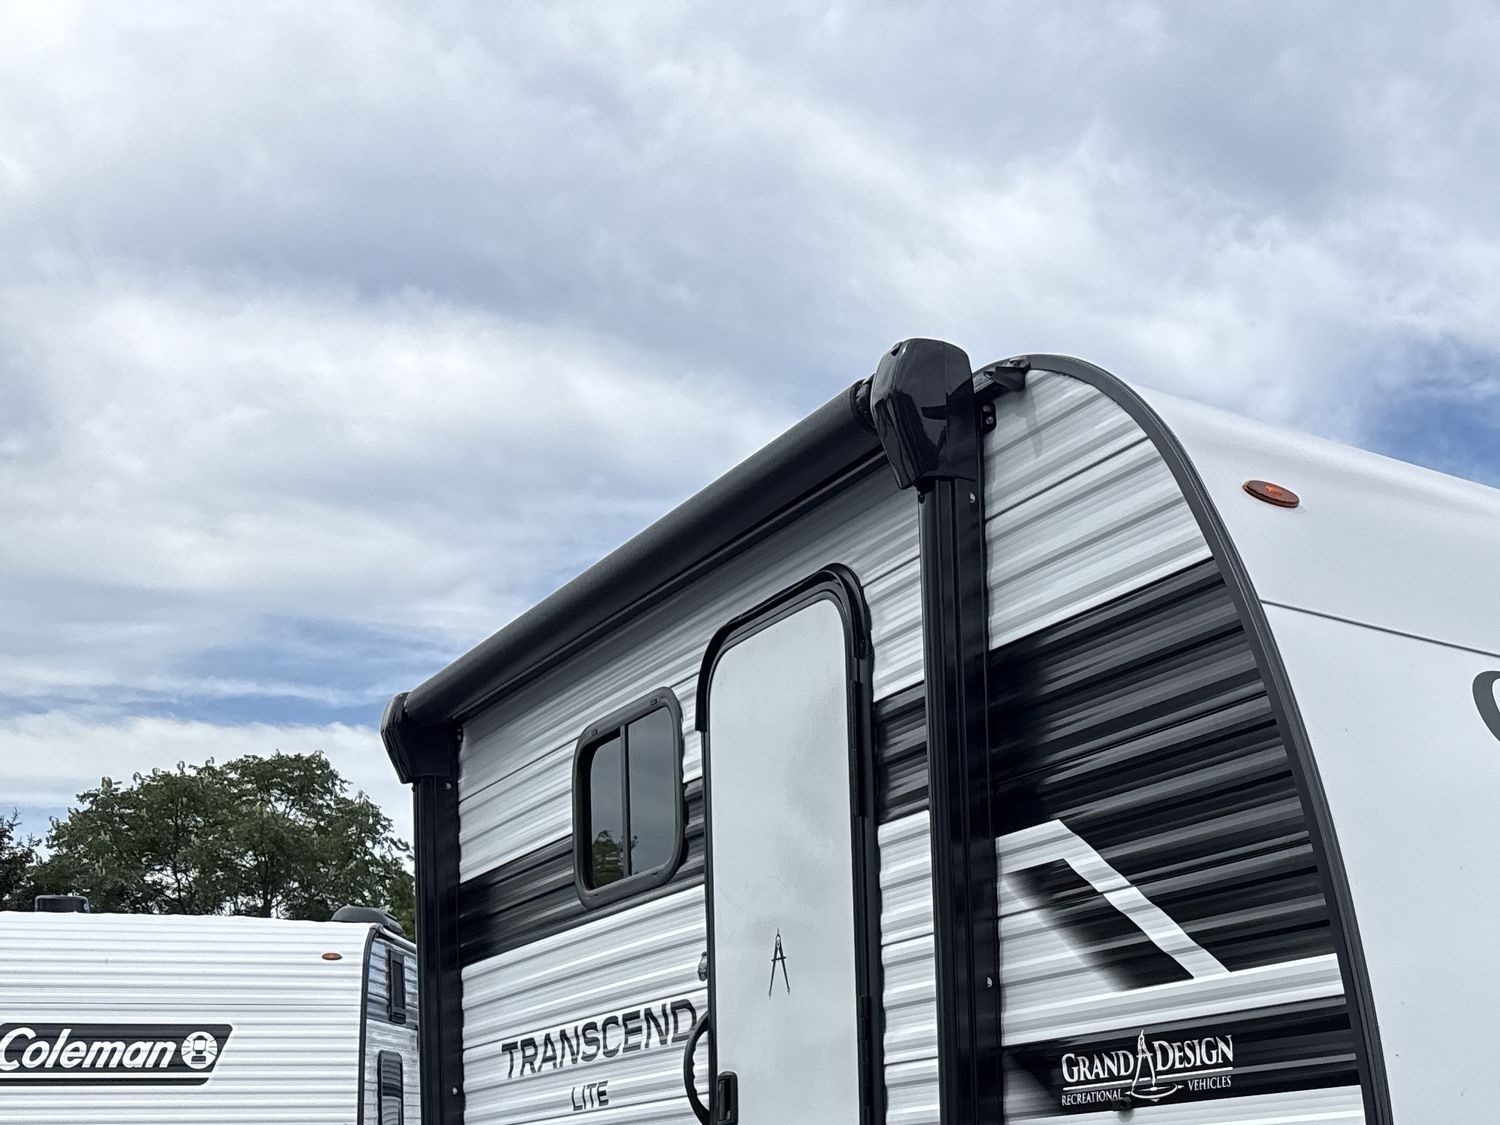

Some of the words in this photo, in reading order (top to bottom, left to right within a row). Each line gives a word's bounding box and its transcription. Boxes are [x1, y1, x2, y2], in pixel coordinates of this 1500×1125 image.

[0, 1027, 177, 1072] Coleman
[501, 998, 697, 1080] TRANSCEND
[1061, 1050, 1135, 1083] GRAND
[1151, 1034, 1234, 1072] DESIGN
[570, 1080, 610, 1112] LITE
[1061, 1088, 1124, 1107] RECREATIONAL
[1187, 1075, 1232, 1092] VEHICLES
